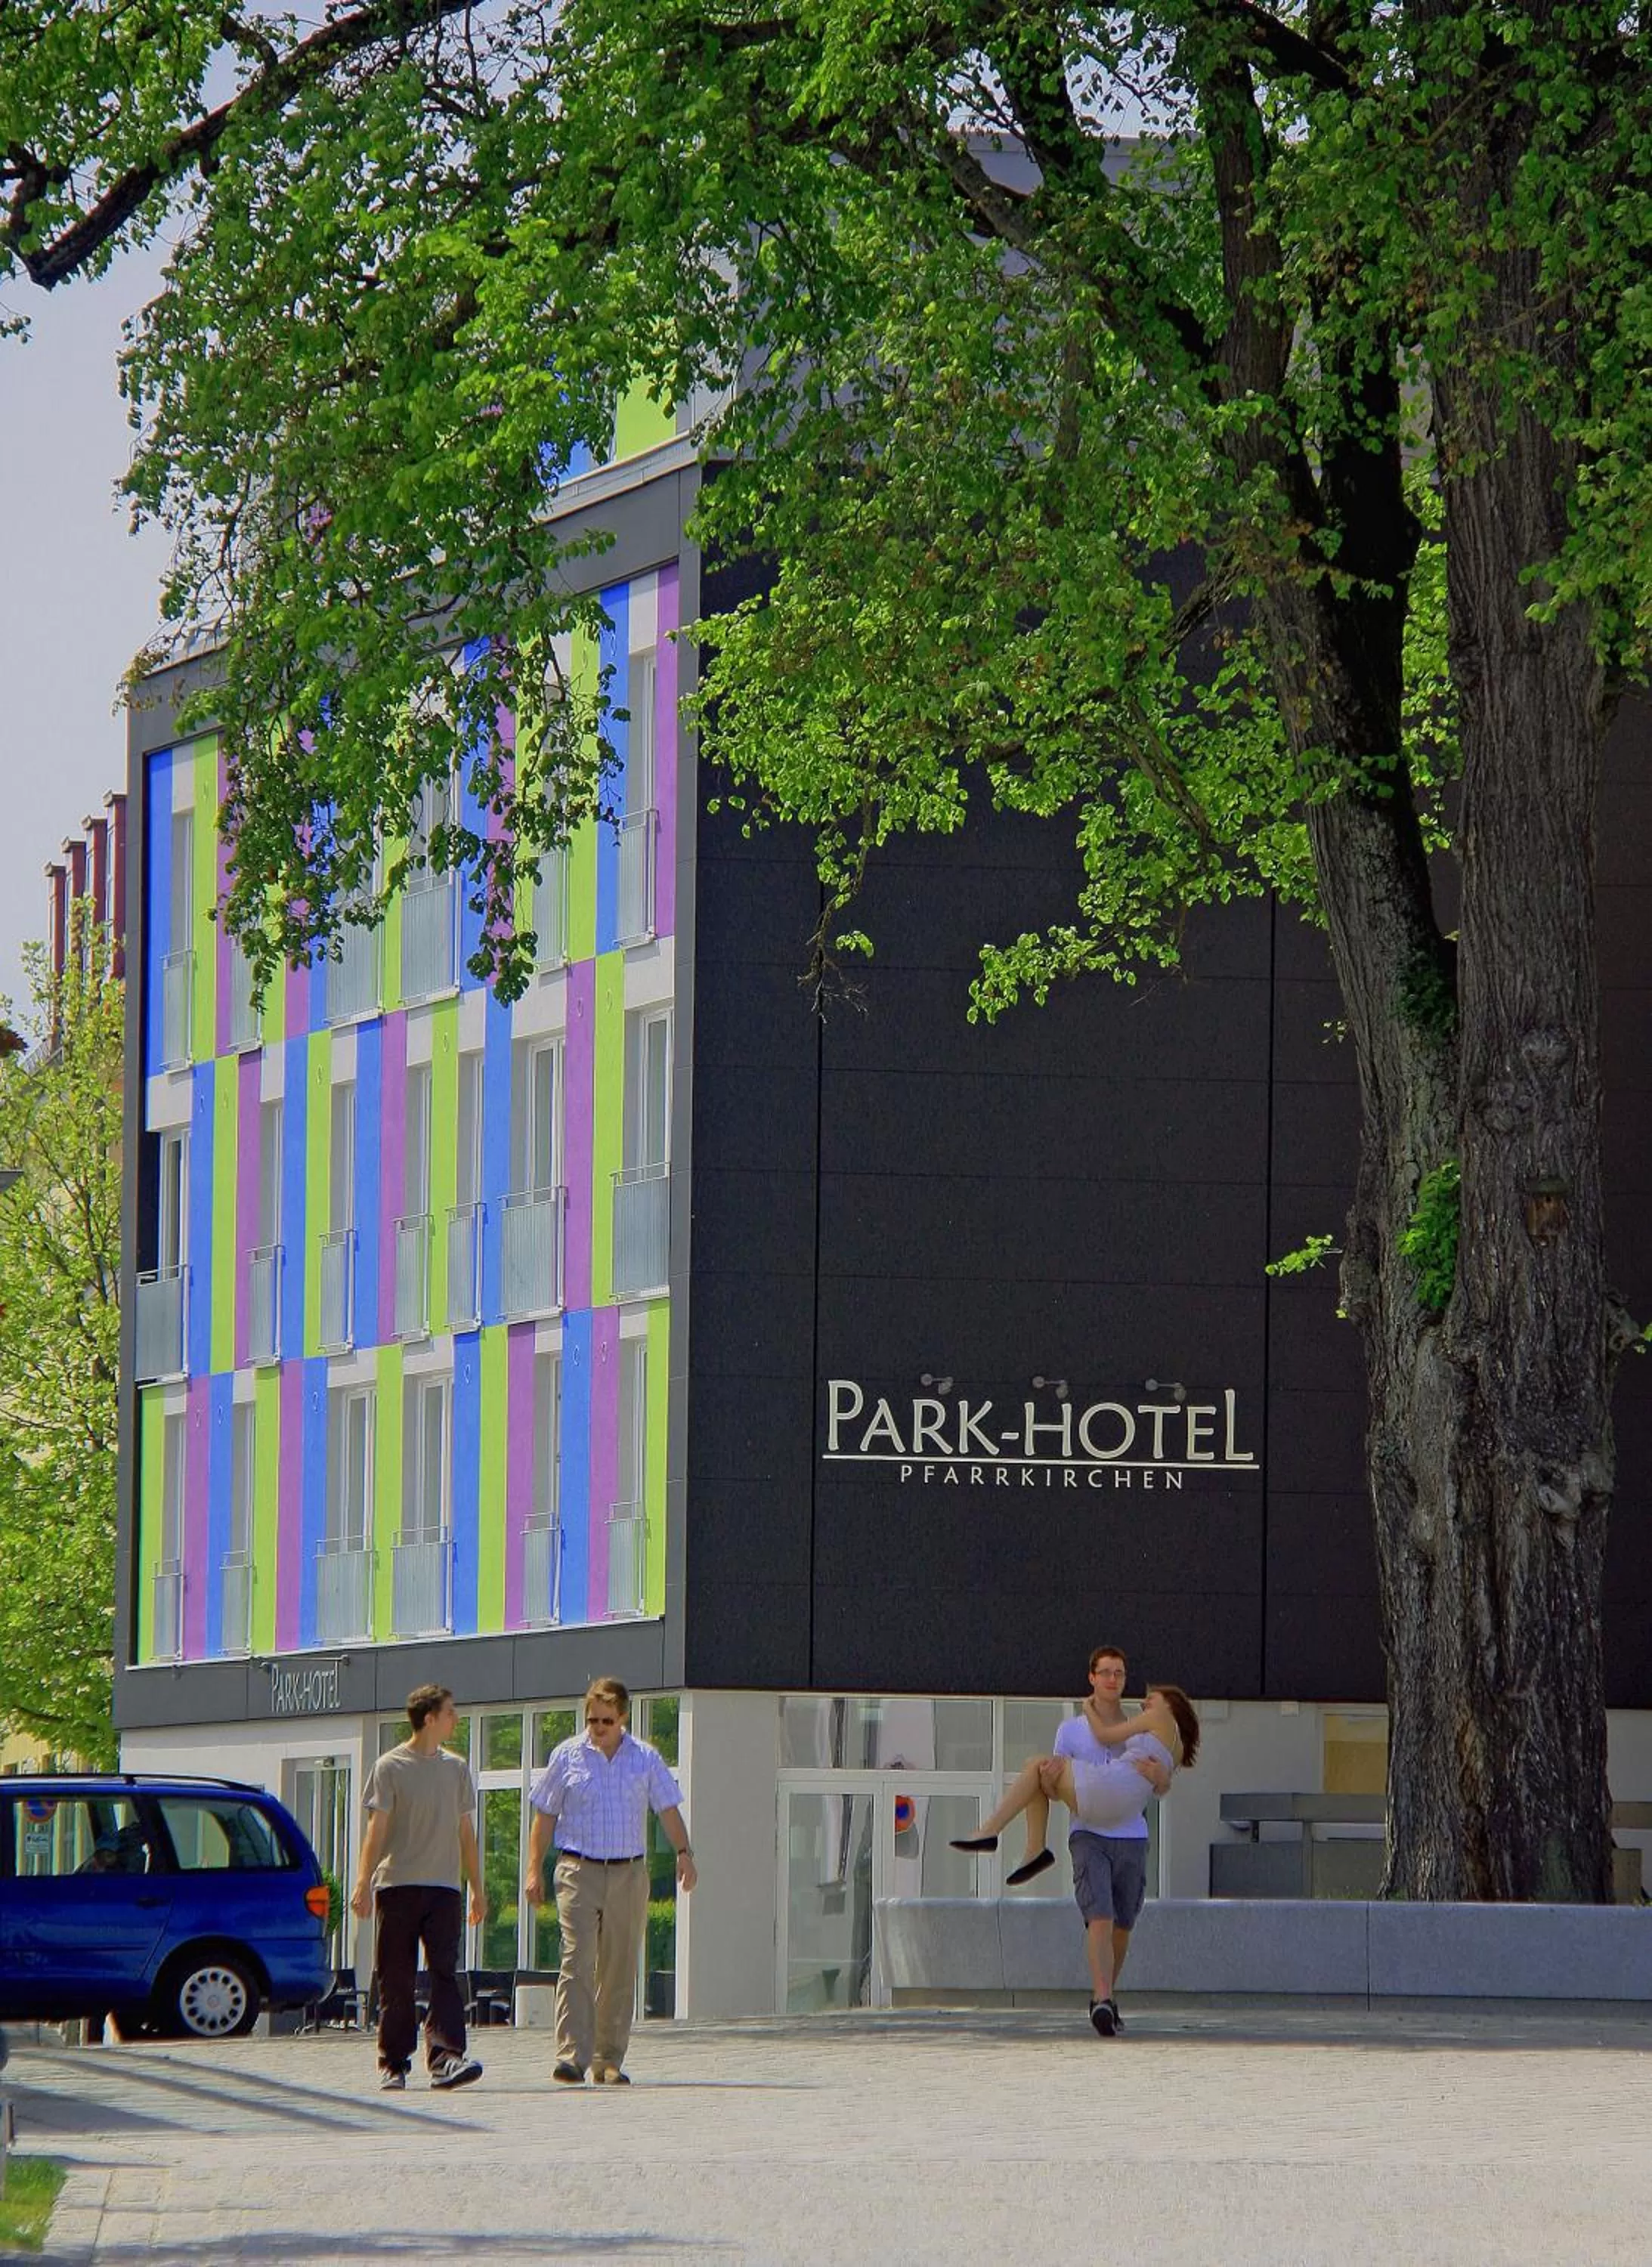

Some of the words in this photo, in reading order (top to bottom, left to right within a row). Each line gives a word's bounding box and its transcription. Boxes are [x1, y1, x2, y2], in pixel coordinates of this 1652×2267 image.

[828, 1380, 1254, 1461] PARK-HOTEL
[900, 1465, 1184, 1489] PFARRKIRCHEN
[271, 1661, 341, 1712] PARK-HOTEL
